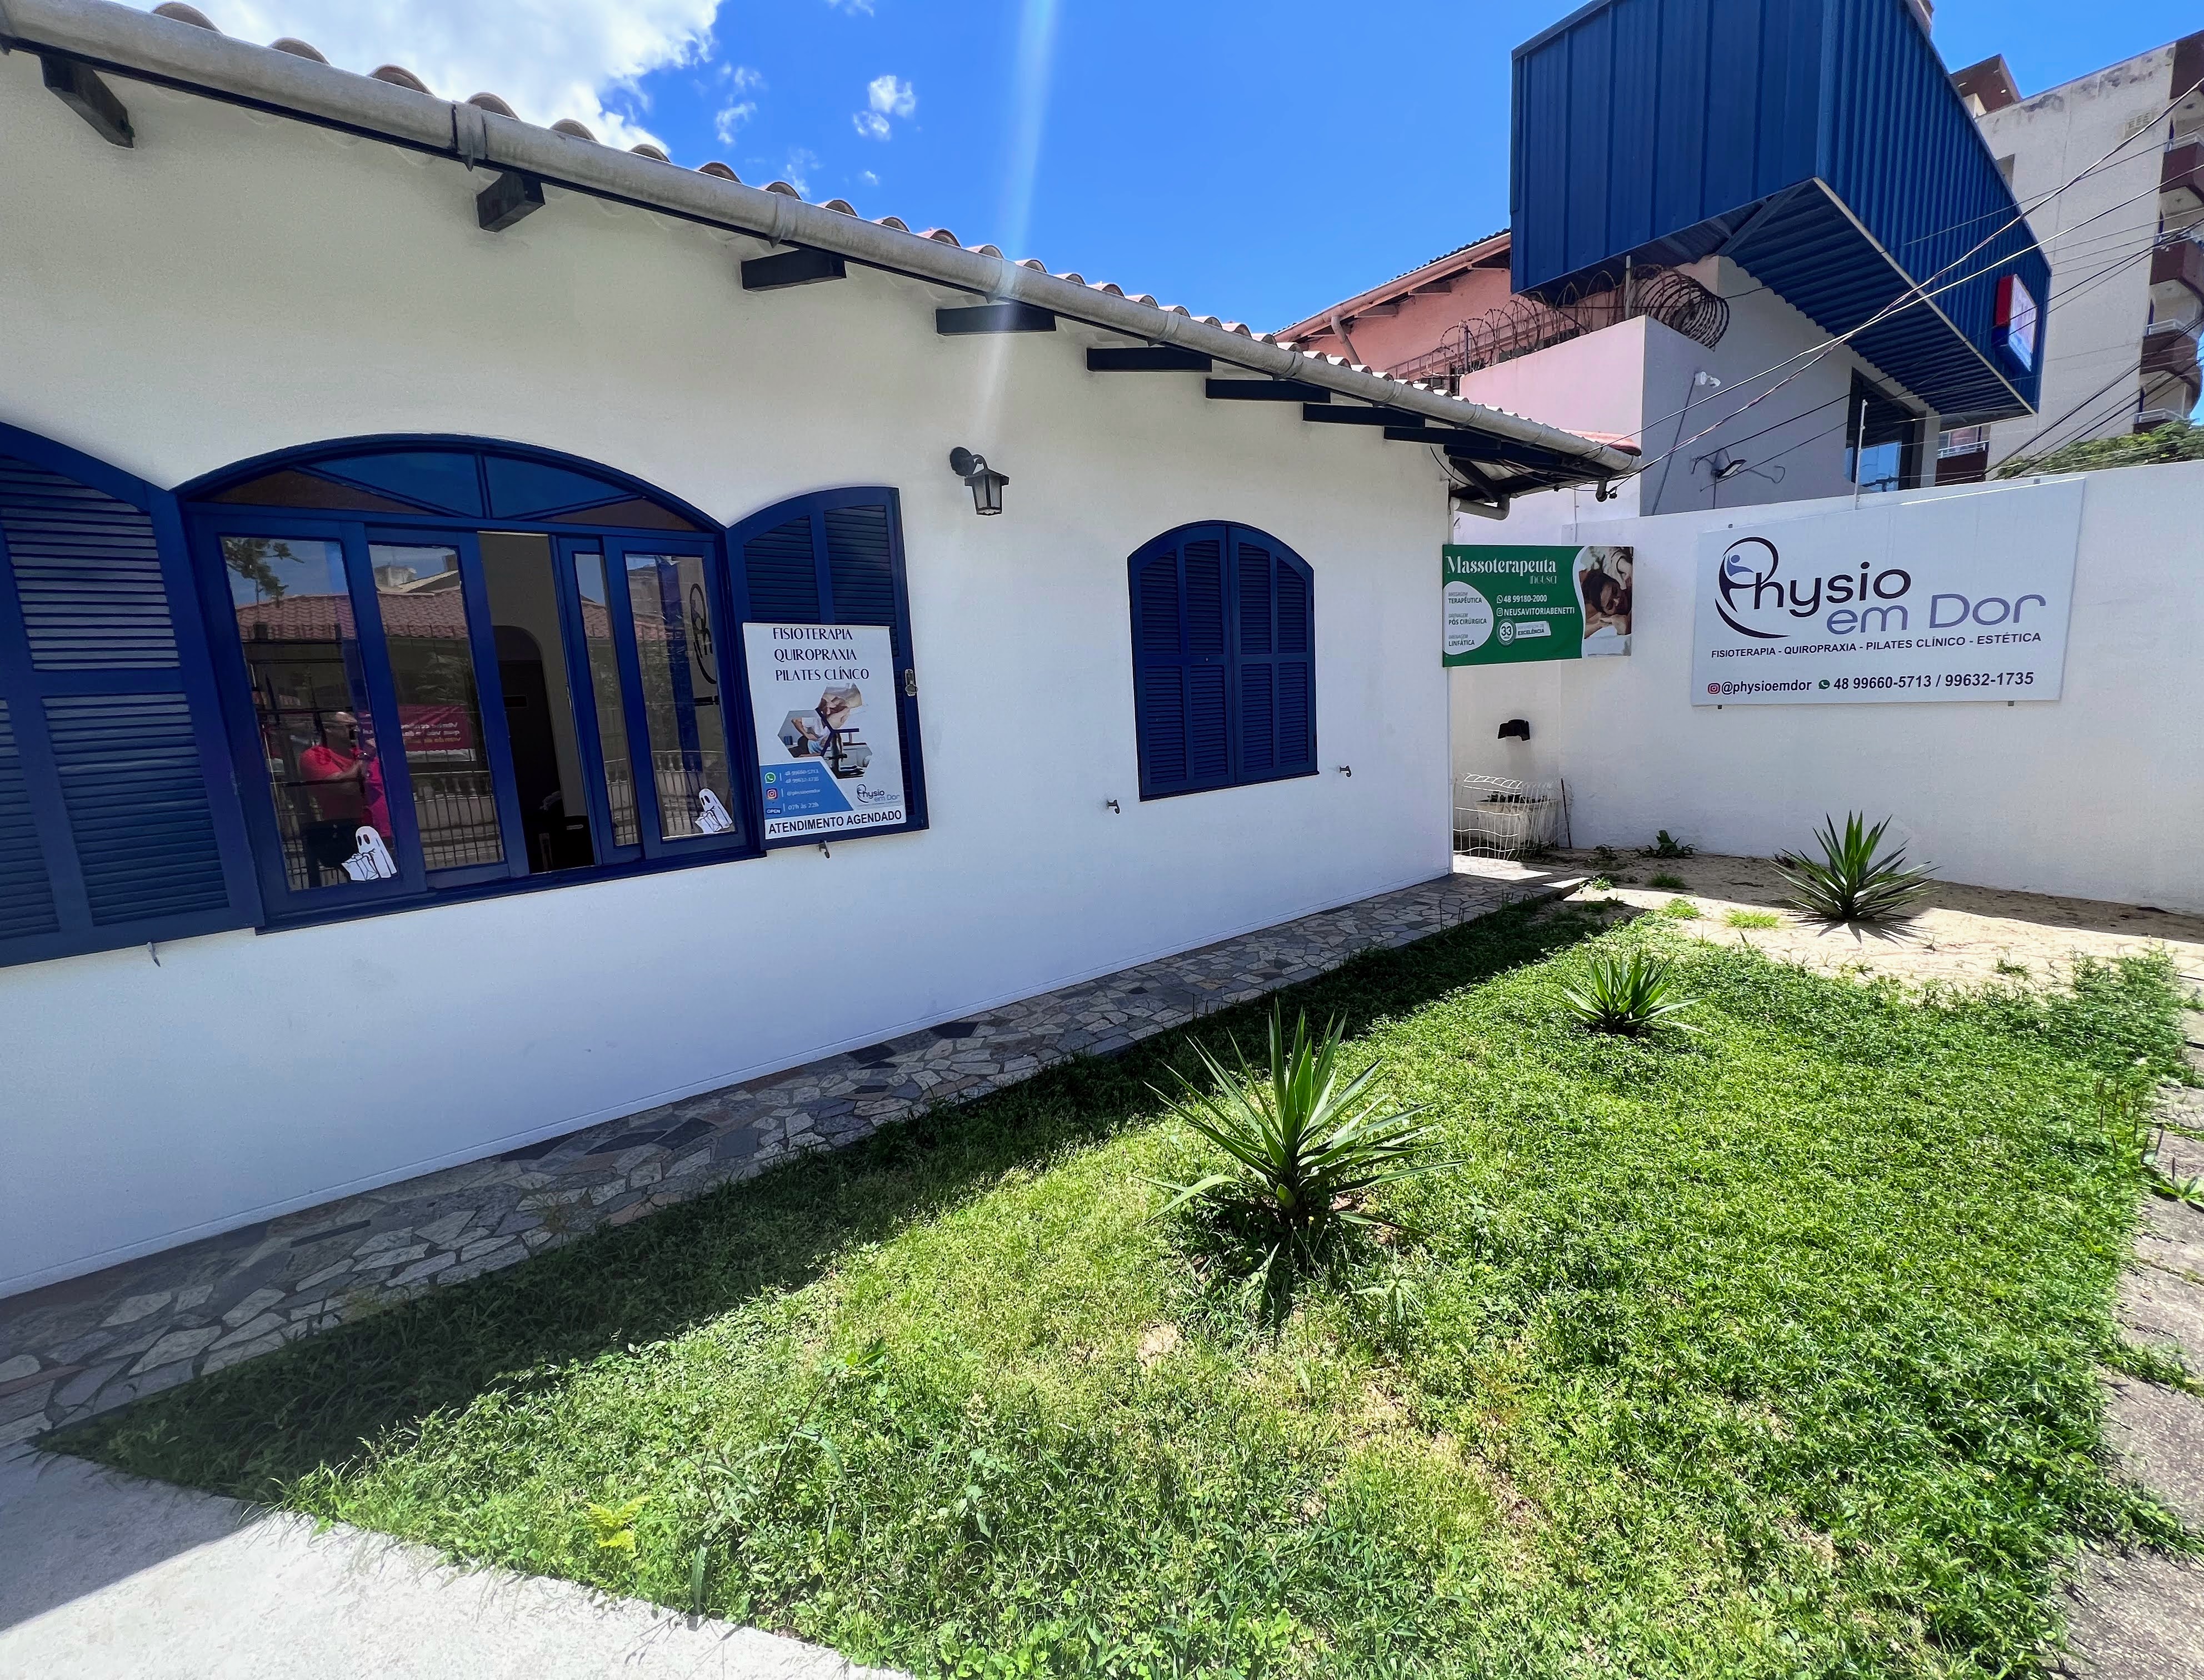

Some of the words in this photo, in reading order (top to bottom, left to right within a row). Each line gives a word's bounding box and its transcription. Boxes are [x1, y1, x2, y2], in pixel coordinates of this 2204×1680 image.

[1445, 556, 1556, 577] Massoterapeuta
[1715, 536, 1912, 639] Physio
[1512, 594, 1547, 603] 99180-2000
[1504, 607, 1575, 616] NEUSAVITORIABENETTI
[1826, 604, 1908, 635] em
[1929, 593, 2046, 629] Dor
[773, 628, 853, 640] FISIOTERAPIA
[1501, 626, 1512, 636] 33
[1711, 648, 1776, 658] FISIOTERAPIA
[1784, 643, 1857, 655] QUIROPRAXIA
[1866, 639, 1912, 651] PILATES
[1916, 636, 1966, 648] CLÍNICO
[1977, 632, 2042, 645] ESTÉTICA
[774, 648, 857, 662] QUIROPRAXIA
[775, 669, 821, 681] PILATES
[824, 666, 869, 680] CLÍNICO
[1722, 679, 1812, 695] @physioemdor
[1833, 678, 1848, 689] 48
[1853, 674, 1932, 689] 99660-5713
[1945, 671, 2034, 687] 99632-1735
[857, 784, 884, 803] Physio
[768, 816, 843, 834] ATENDIMENTO
[846, 809, 902, 826] AGENDADO
